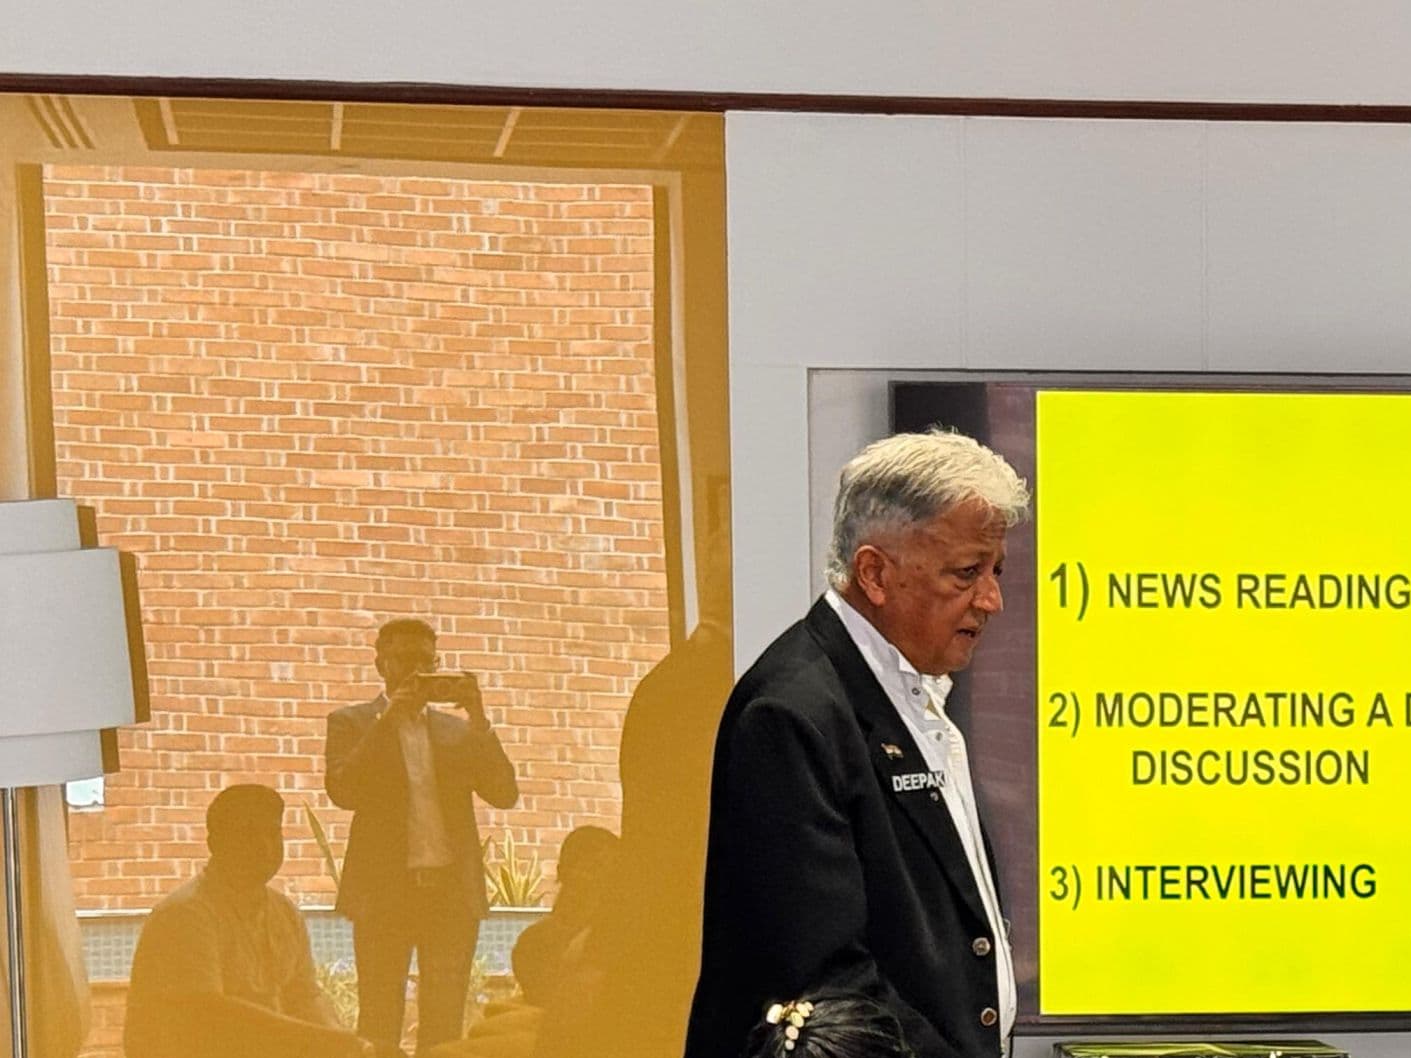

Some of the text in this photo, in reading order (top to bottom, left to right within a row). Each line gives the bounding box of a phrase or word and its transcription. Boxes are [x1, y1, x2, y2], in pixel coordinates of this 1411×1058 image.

[1050, 562, 1411, 621] 1) NEWS READING
[1048, 691, 1081, 738] 2)
[1096, 691, 1355, 728] MODERATING
[1366, 692, 1393, 727] A
[892, 771, 945, 792] DEEPAK
[1132, 749, 1369, 786] DISCUSSION
[1050, 863, 1377, 911] 3) INTERVIEWING
